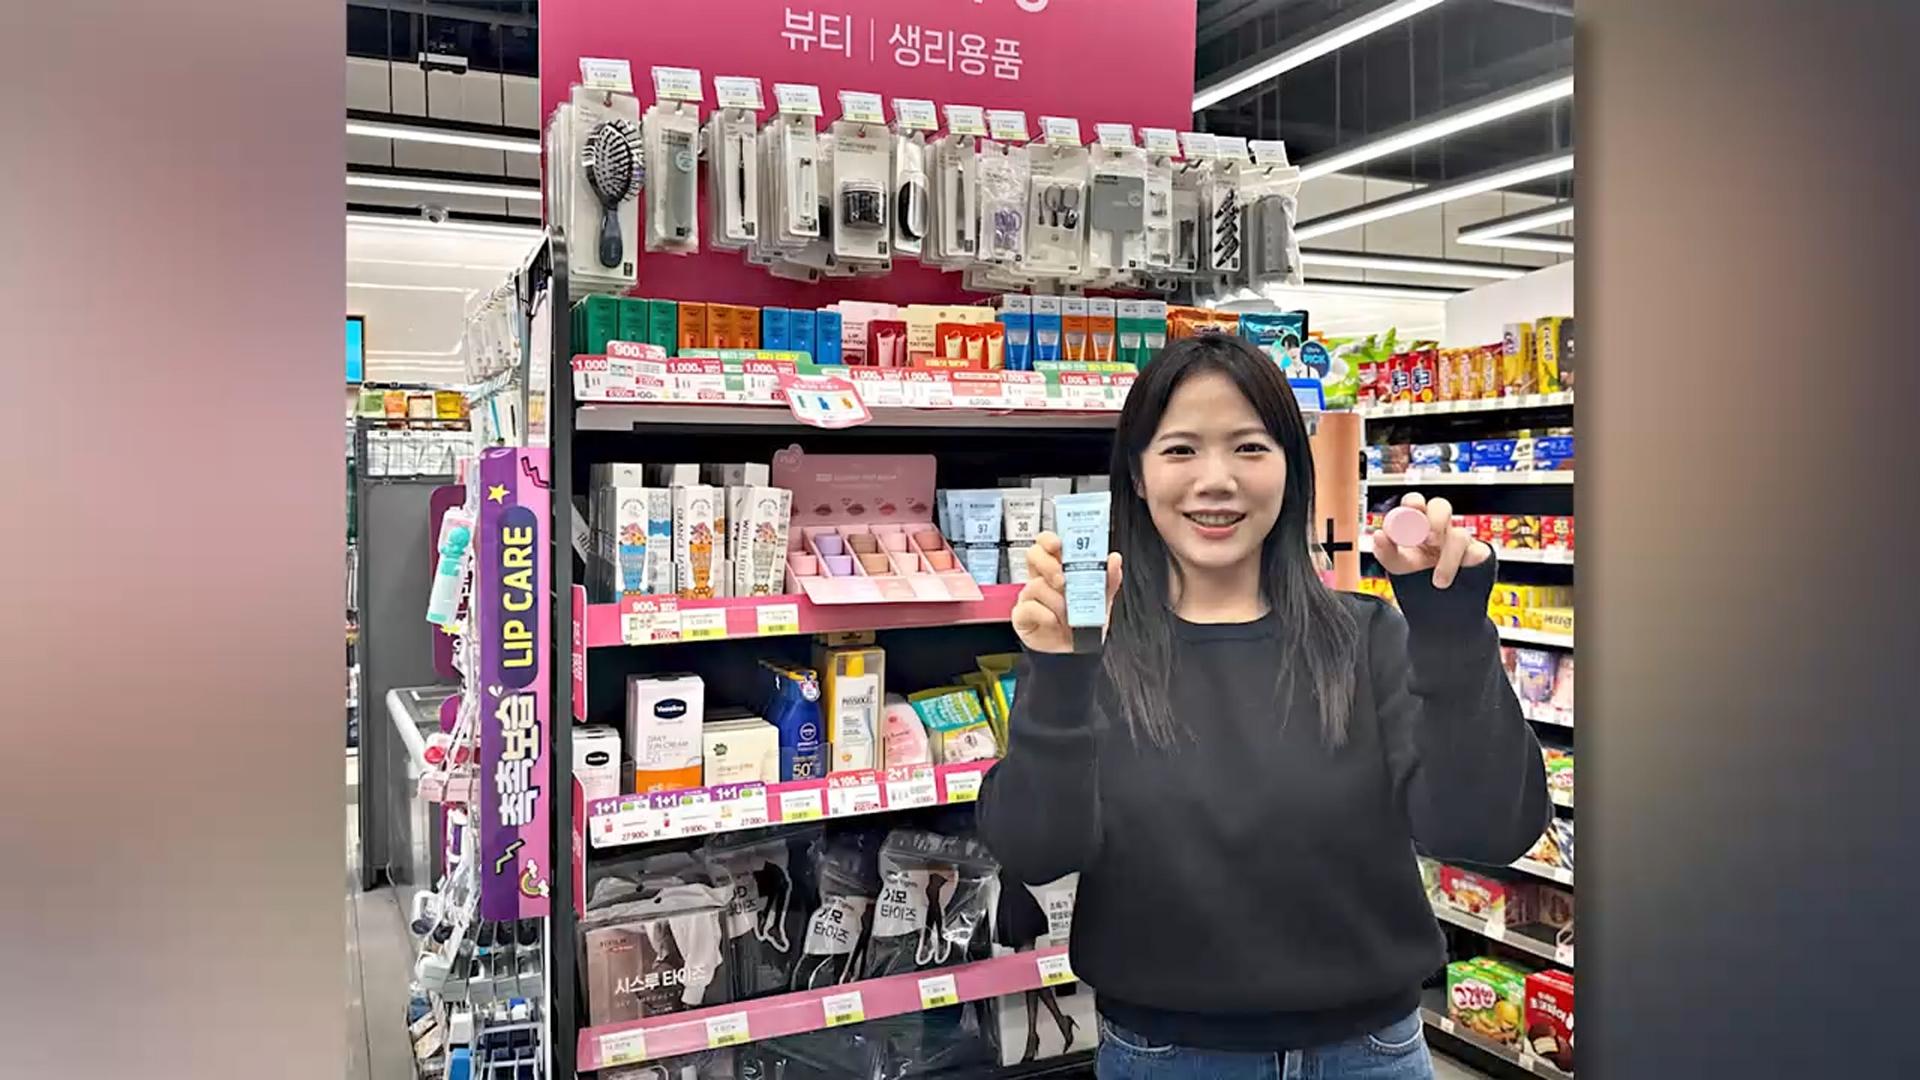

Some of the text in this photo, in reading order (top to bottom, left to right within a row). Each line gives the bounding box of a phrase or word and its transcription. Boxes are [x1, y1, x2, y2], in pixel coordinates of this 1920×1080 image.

[781, 8, 1023, 81] 뷰티 생리용품
[1076, 537, 1090, 550] 97
[503, 527, 534, 667] LIP CARE
[495, 694, 540, 826] 촉촉보습
[887, 768, 910, 781] 2+1
[655, 794, 680, 807] 1+1
[716, 787, 738, 800] 1+1
[595, 801, 619, 814] 1+1
[881, 904, 916, 921] 타이즈
[615, 965, 707, 996] 시스루 타이즈
